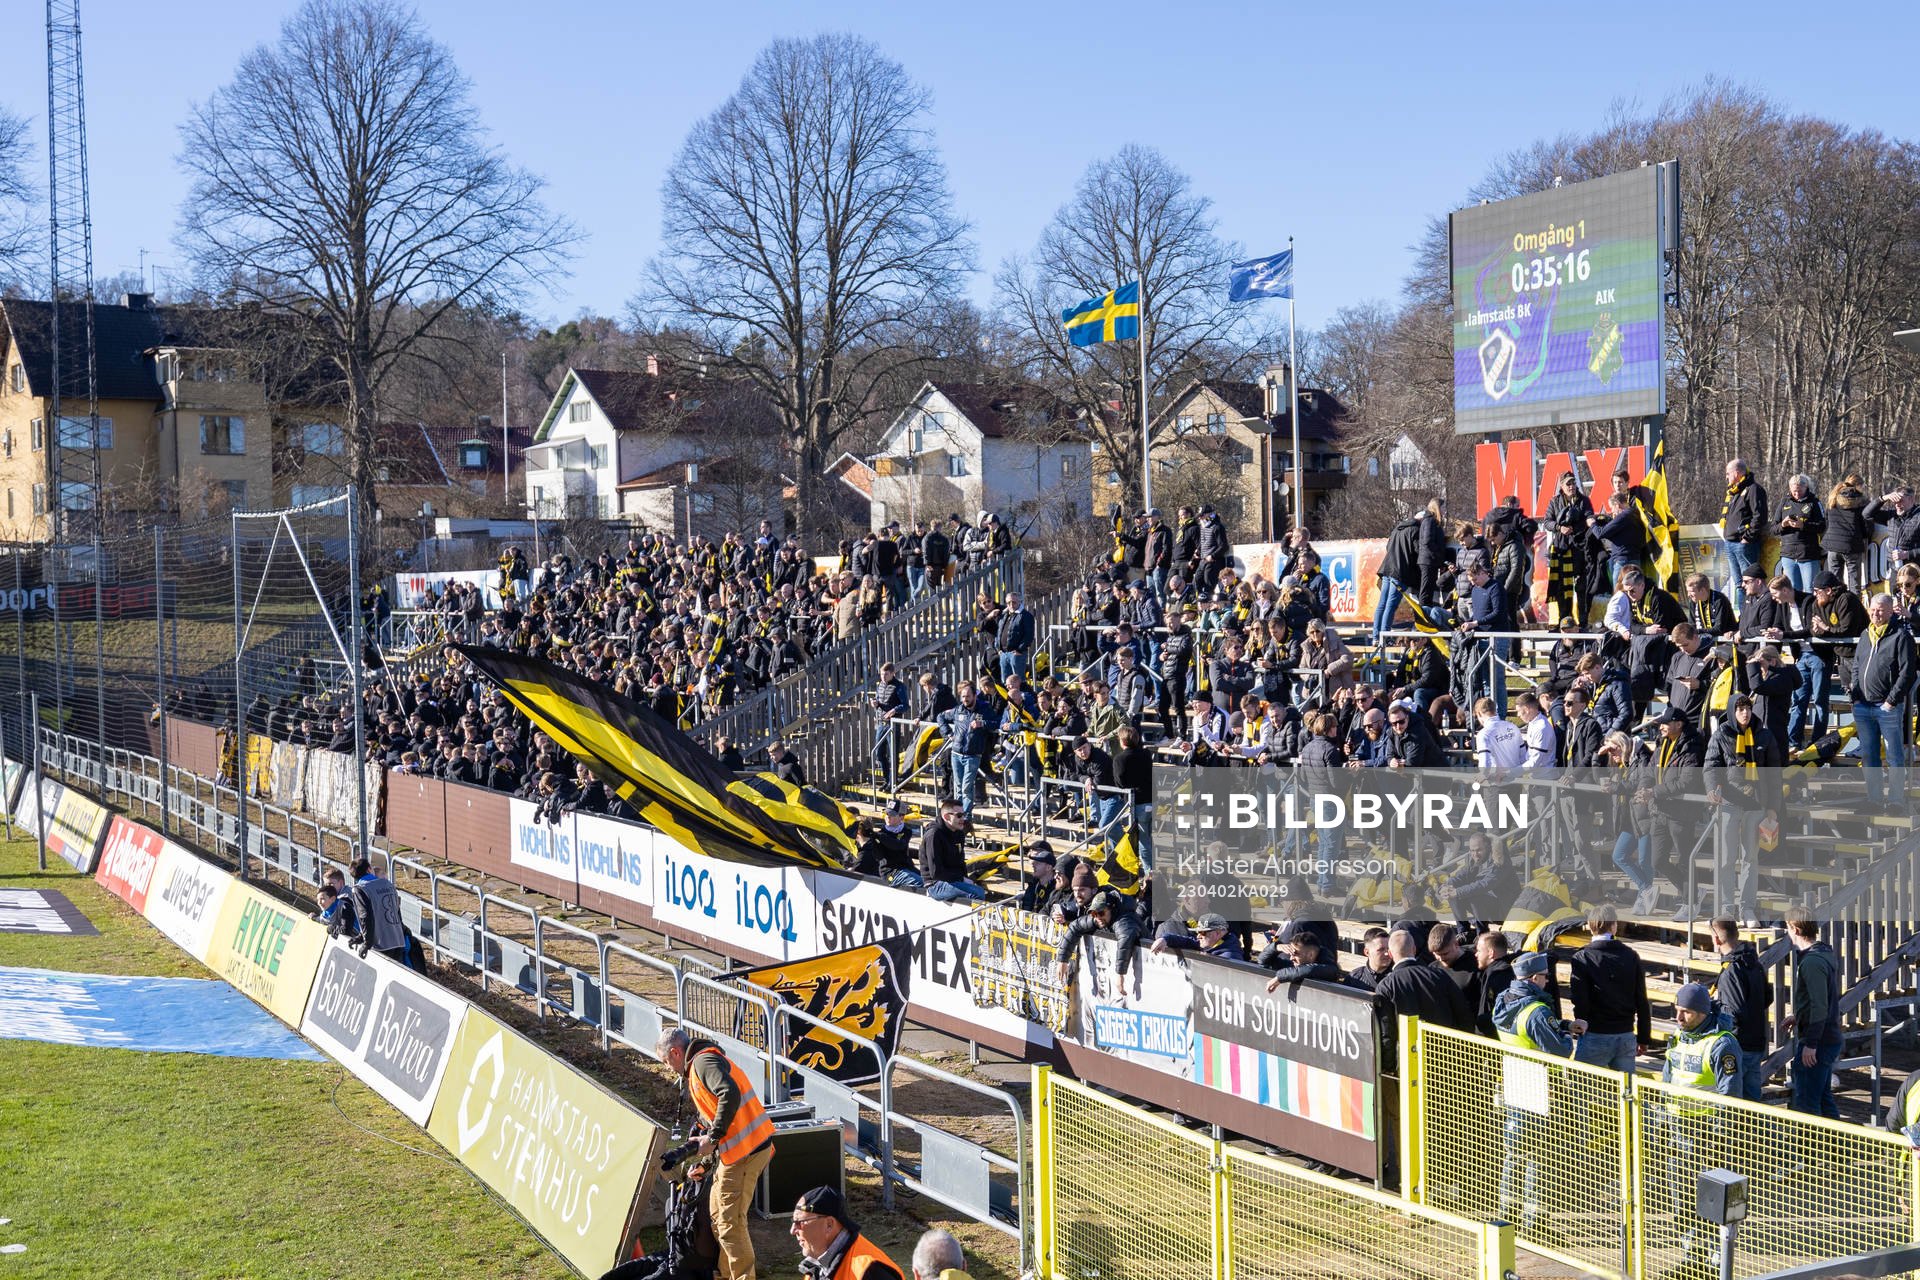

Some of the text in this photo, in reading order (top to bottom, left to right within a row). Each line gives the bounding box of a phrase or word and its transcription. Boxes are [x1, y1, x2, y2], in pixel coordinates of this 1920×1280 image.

[1513, 219, 1585, 253] Omgång 1
[1511, 248, 1591, 293] 0:35:16
[1595, 288, 1616, 305] AIK
[1517, 302, 1532, 319] BK
[169, 864, 215, 922] weber
[665, 854, 717, 918] iLOQ
[736, 873, 797, 943] iLOQ
[232, 896, 296, 977] HYLTE
[1097, 1009, 1187, 1056] SIGGES CIRKUS
[1203, 982, 1360, 1060] SIGN SOLUTIONS
[509, 1068, 615, 1172] HALMSTADS
[492, 1114, 599, 1237] STENHUS
